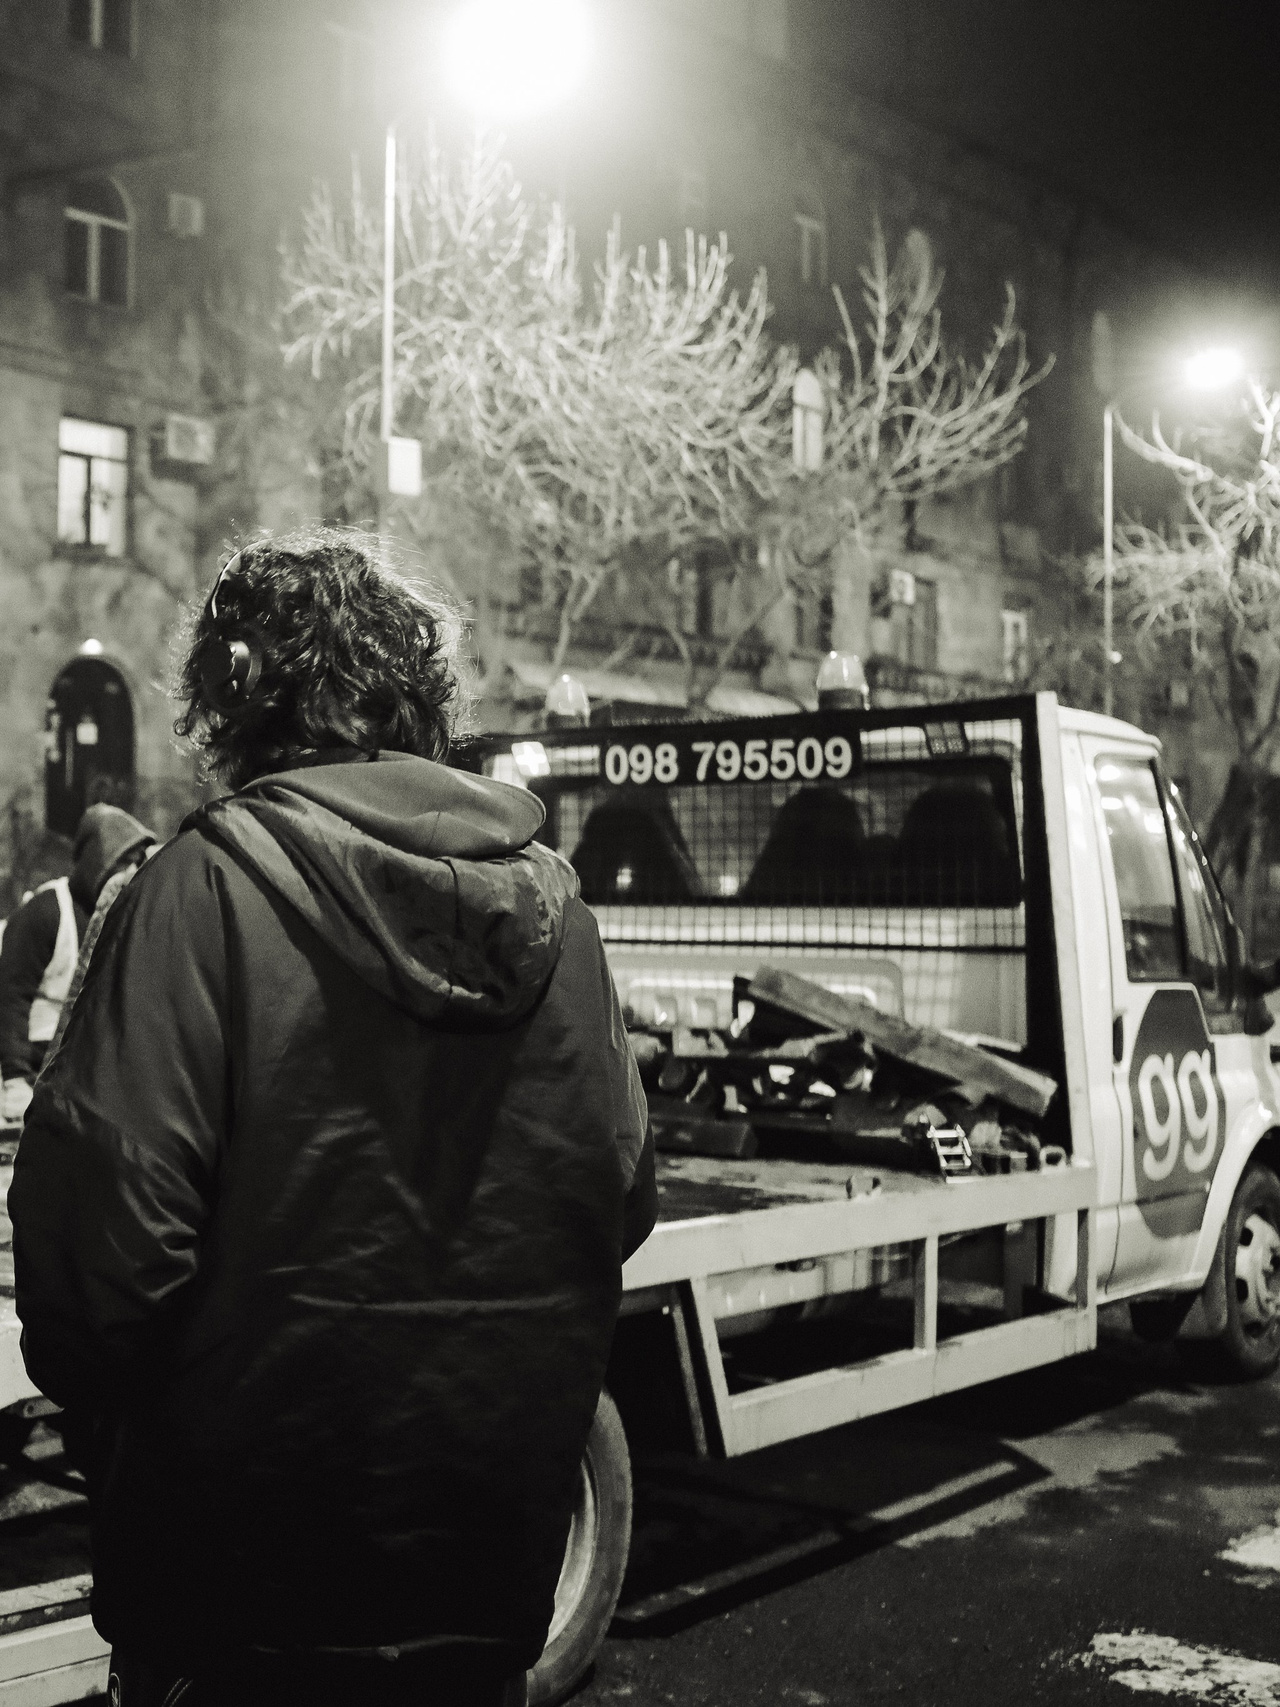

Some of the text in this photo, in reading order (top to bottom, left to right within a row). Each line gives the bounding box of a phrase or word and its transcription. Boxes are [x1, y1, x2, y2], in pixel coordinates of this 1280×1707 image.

[605, 736, 852, 785] 098 795509
[1138, 1049, 1219, 1182] gg
